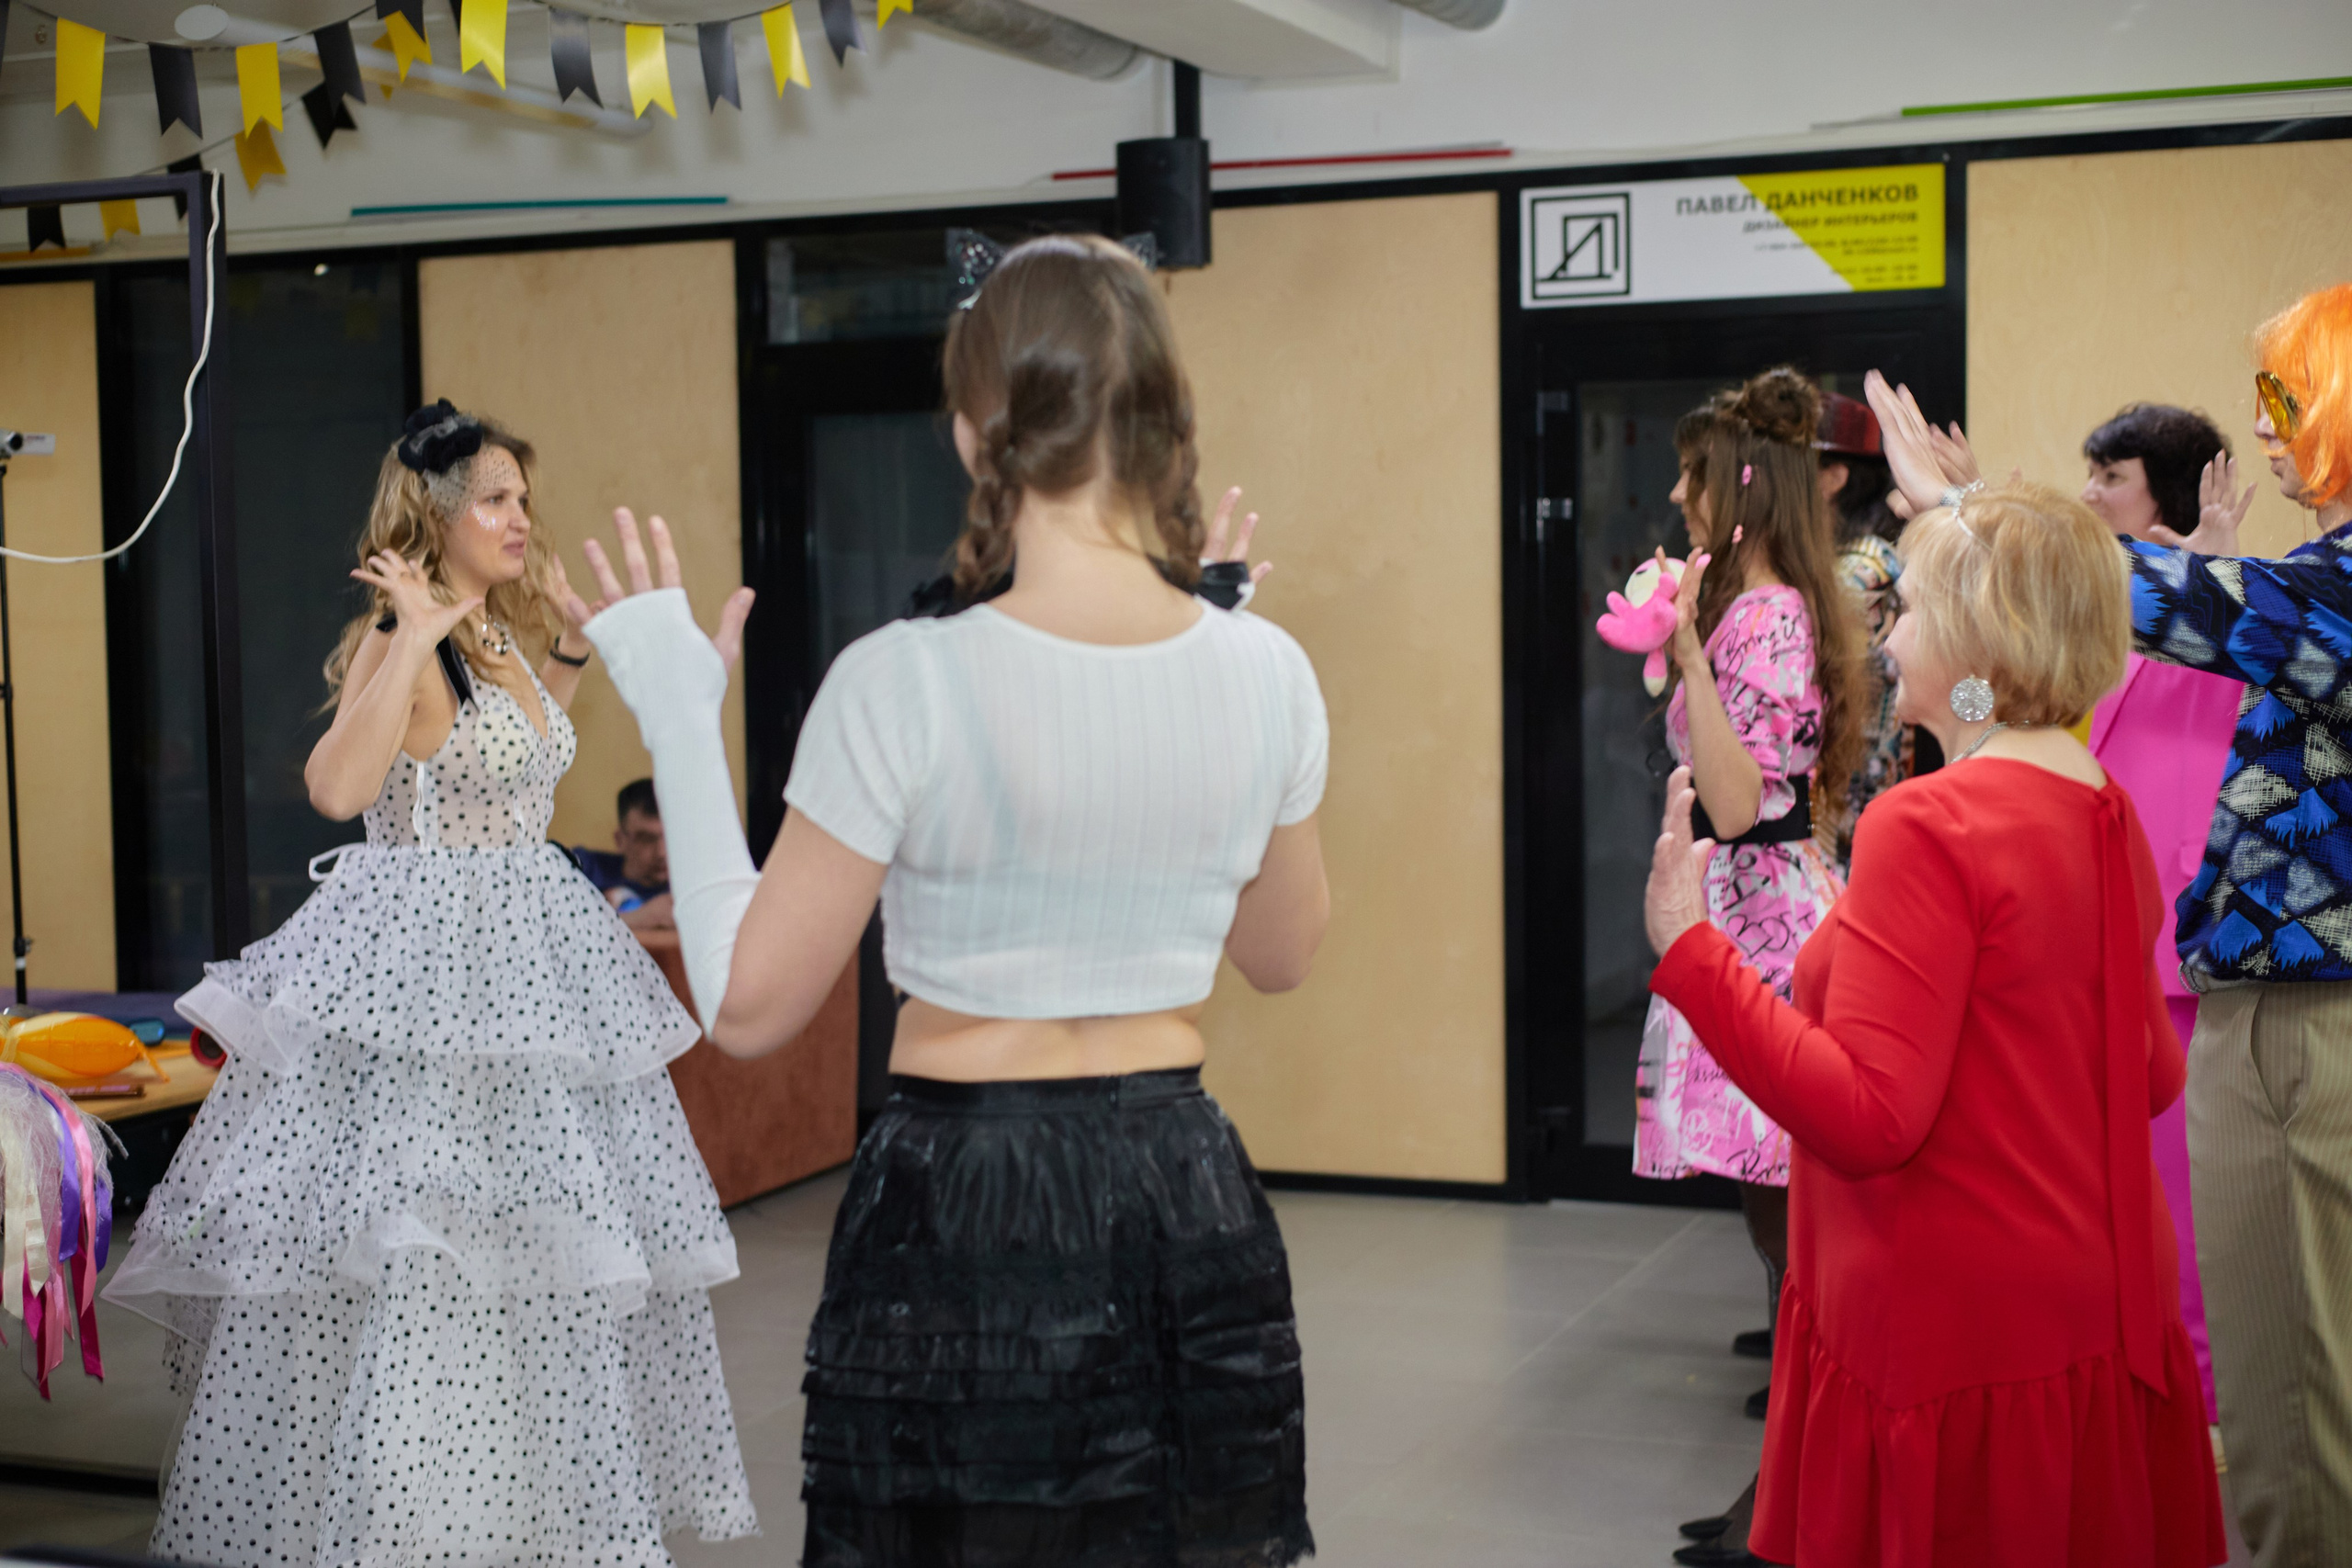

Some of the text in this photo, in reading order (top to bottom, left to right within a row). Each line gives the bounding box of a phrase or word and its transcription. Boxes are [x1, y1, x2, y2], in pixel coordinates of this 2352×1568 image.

[1676, 183, 1917, 216] ПАВЕЛ ДАНЧЕНКОВ
[1743, 211, 1917, 233] ДИЗАЙНЕР ИНТЕРЬЕРОВ
